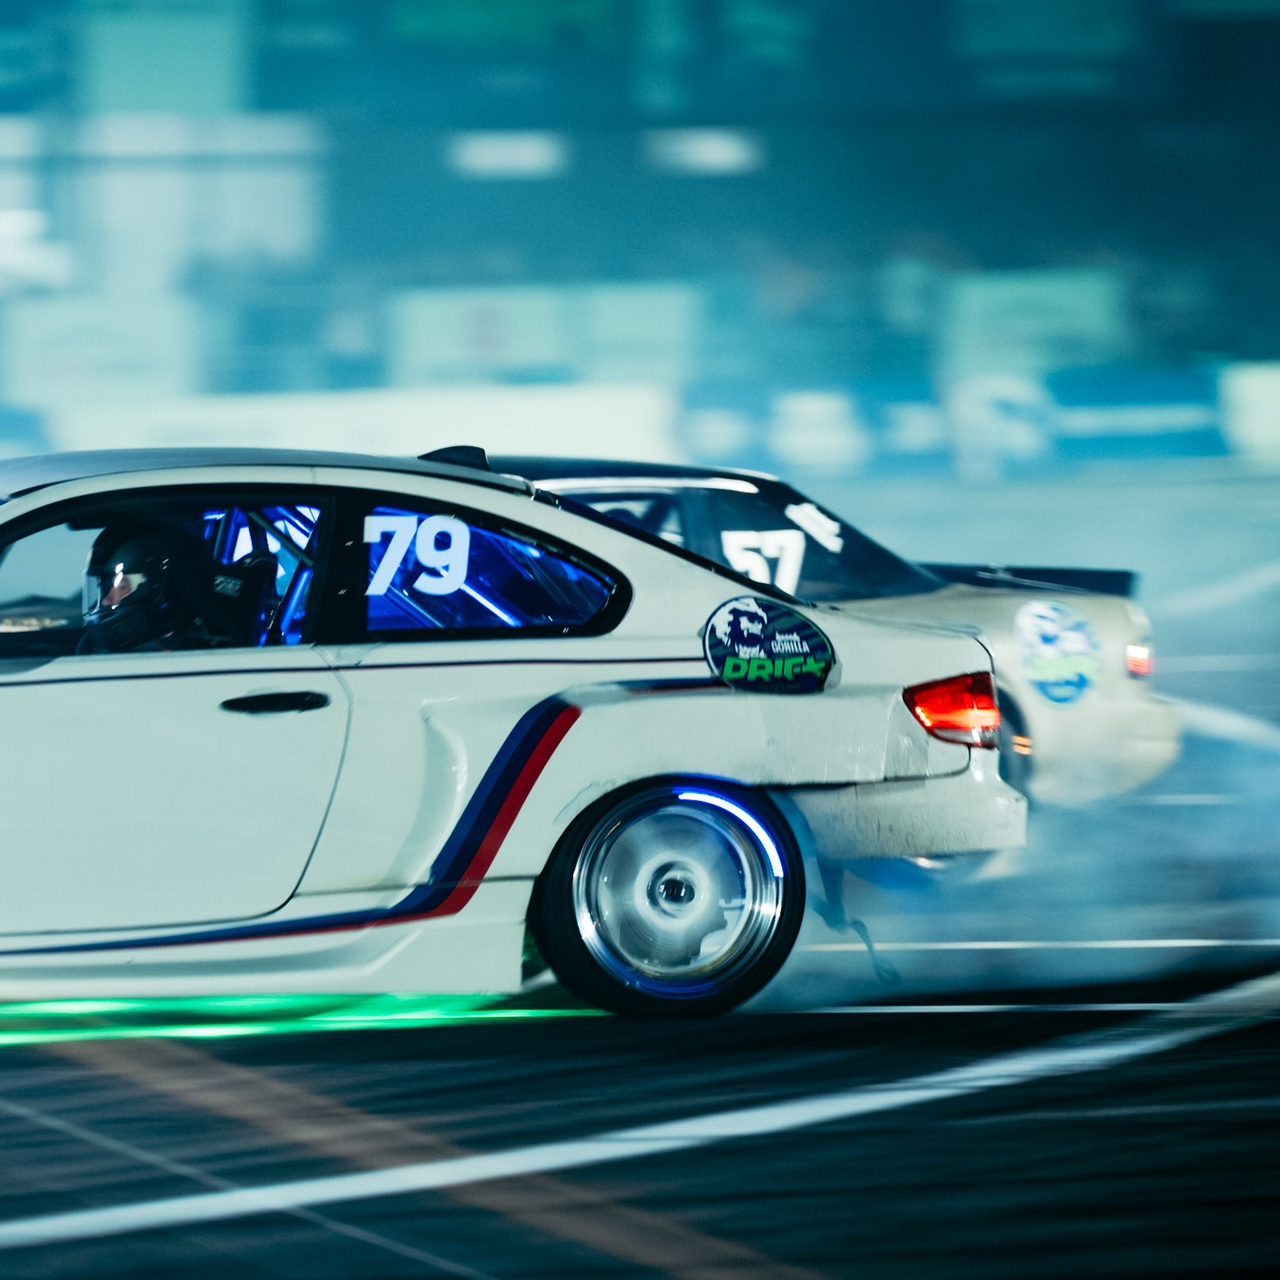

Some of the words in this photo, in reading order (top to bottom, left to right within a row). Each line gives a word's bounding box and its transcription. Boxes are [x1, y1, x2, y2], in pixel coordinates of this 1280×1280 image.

[363, 514, 470, 596] 79
[721, 529, 806, 596] 57
[771, 639, 810, 654] GORILLA
